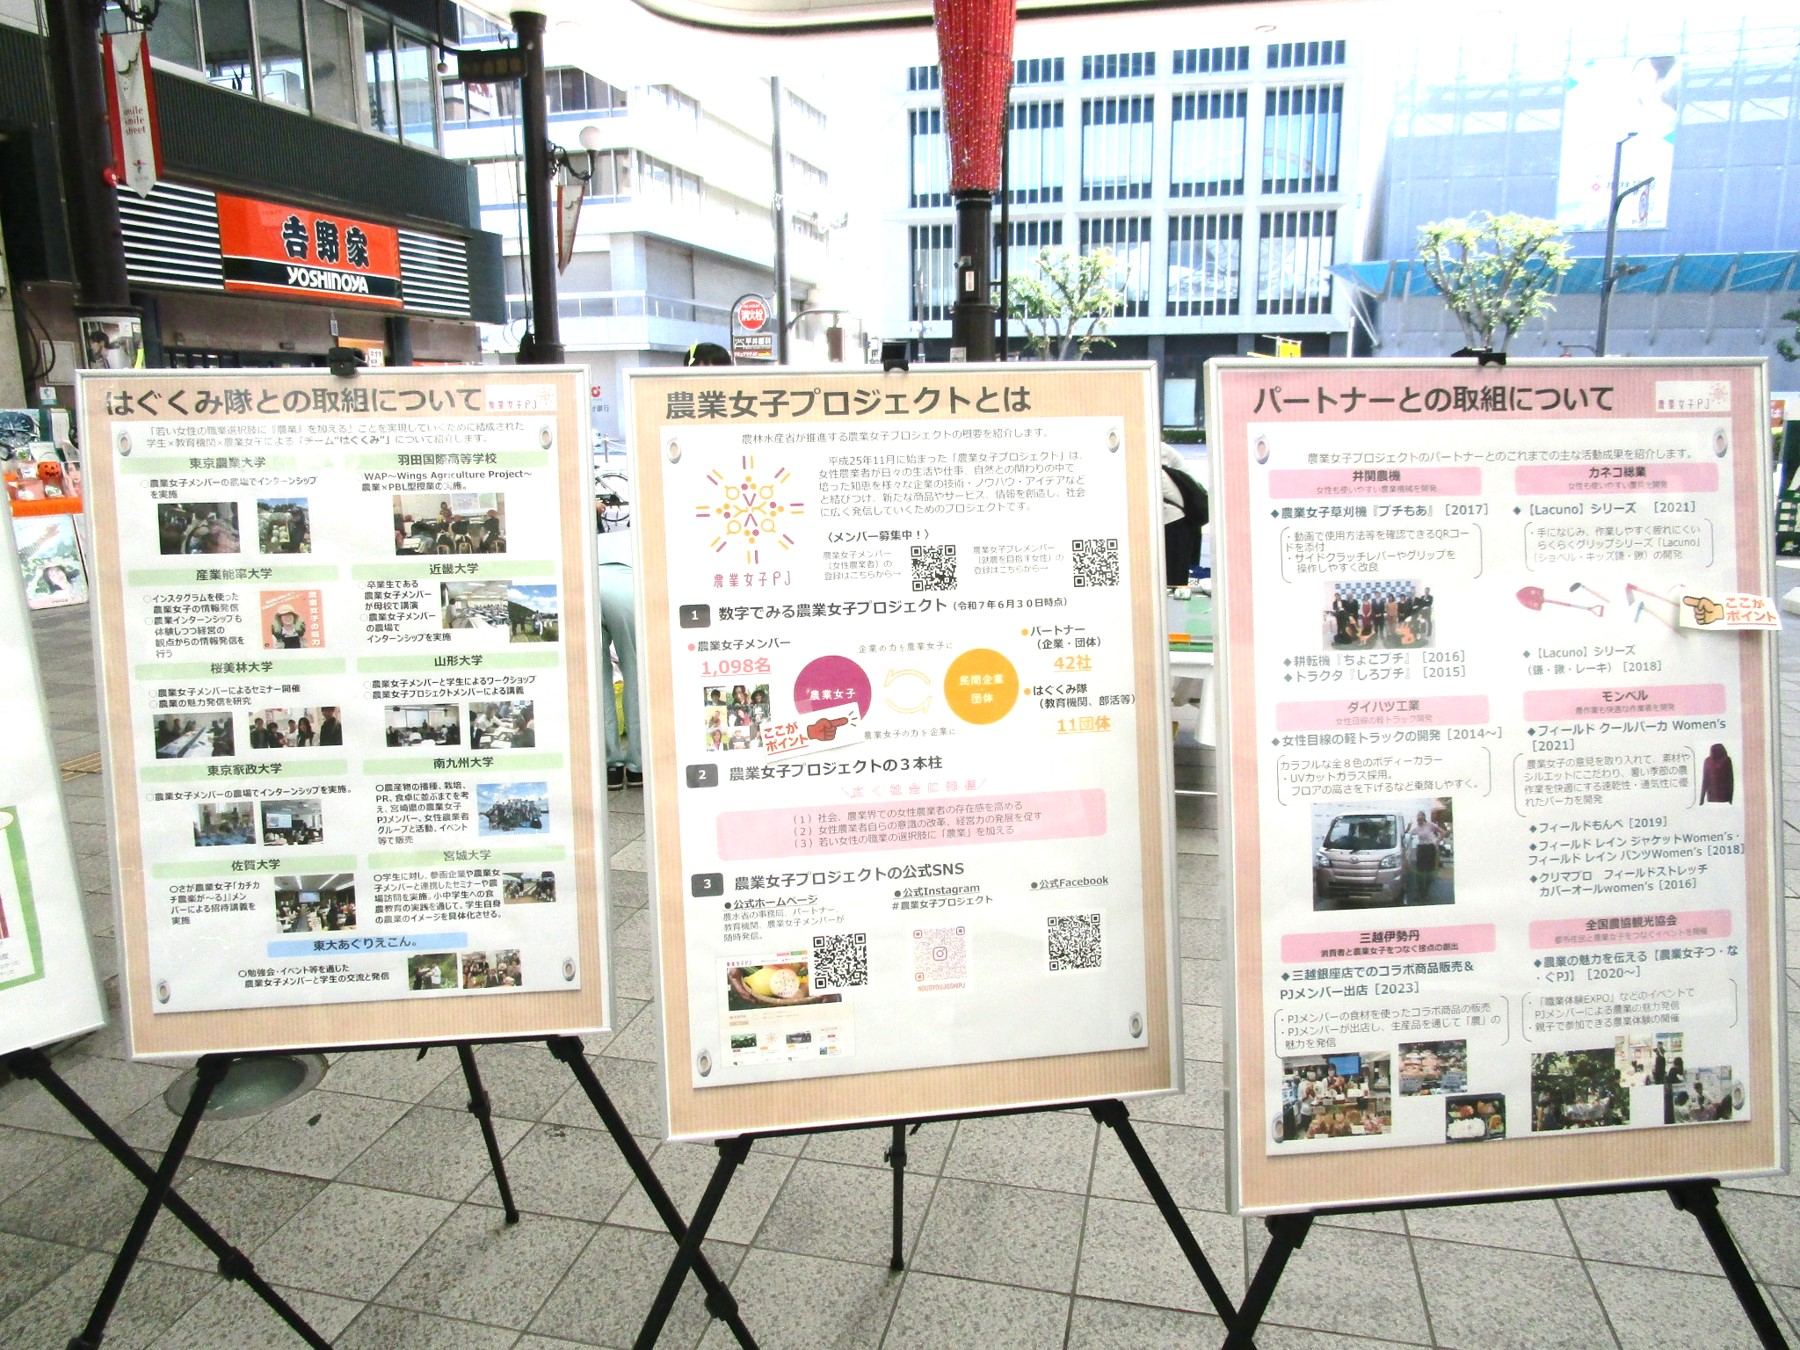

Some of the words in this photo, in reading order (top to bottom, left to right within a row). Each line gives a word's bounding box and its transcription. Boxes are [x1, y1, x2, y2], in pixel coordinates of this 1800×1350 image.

[126, 126, 146, 135] street
[282, 214, 370, 269] 吉野家
[287, 267, 368, 293] YOSHINOYA
[741, 310, 763, 321] 消火栓
[106, 386, 482, 416] はぐくみ隊との取組について
[666, 386, 1031, 419] 農業女子プロジェクトとは
[1253, 386, 1615, 414] パートナーとの取組について
[189, 456, 266, 469] 東京農業大学
[397, 453, 497, 465] 羽田国際高等学校
[1352, 470, 1401, 482] 井関農機
[1589, 467, 1646, 479] カネコ総業
[151, 490, 178, 498] を実施
[196, 568, 273, 580] 産業能率大学
[430, 563, 479, 574] 近畿大学
[367, 580, 418, 588] 卒業生である
[713, 570, 791, 588] 農業女子PJ
[153, 592, 239, 602] インスタグラムを使った
[365, 591, 432, 600] 農業女子メンバー
[154, 604, 239, 614] 農業女子の情報発信
[366, 601, 418, 610] が母校で講演
[1727, 597, 1765, 609] ここが
[691, 610, 699, 620] 1
[718, 598, 947, 621] 数字でみる農業女子プロジェクト
[154, 615, 242, 625] 農業インターンシップも
[368, 612, 436, 621] 農業女子メンバー
[1727, 611, 1777, 623] ポイント
[155, 626, 224, 636] 体験しつつ経営の
[366, 624, 400, 632] の農場で
[1031, 625, 1085, 636] パートナー
[155, 637, 245, 647] 観点からの情報発信を
[367, 633, 451, 643] インターンシップを実施
[698, 637, 790, 652] 農業女子メンバー
[434, 655, 483, 667] 山形大学
[702, 657, 772, 676] 1,098名
[1054, 654, 1092, 671] 42社
[211, 661, 273, 674] 桜美林大学
[809, 688, 855, 701] 農業女子
[1033, 683, 1087, 696] はぐくみ隊
[1602, 690, 1648, 702] モンベル
[1348, 700, 1420, 714] ダイハツ工業
[764, 722, 798, 738] ここが
[1057, 716, 1111, 733] 11団体
[766, 734, 809, 753] ポイント
[434, 756, 494, 769] 南九州大学
[729, 755, 943, 781] 農業女子プロジェクトの3本柱
[208, 763, 282, 776] 東京家政大学
[698, 770, 706, 780] 2
[444, 850, 491, 862] 宮城大学
[232, 859, 280, 872] 佐賀大学
[734, 862, 965, 890] 農業女子プロジェクトの公式SNS
[703, 879, 712, 889] 3
[1040, 876, 1108, 890] 公式Facebook
[903, 884, 980, 898] 公式Instagram
[734, 895, 818, 908] 公式ホームページ
[172, 917, 190, 925] 実施
[1586, 915, 1677, 931] 全国農協観光協会
[1360, 930, 1420, 943] 三越伊勢丹
[313, 936, 417, 951] 東大あぐりえこん。
